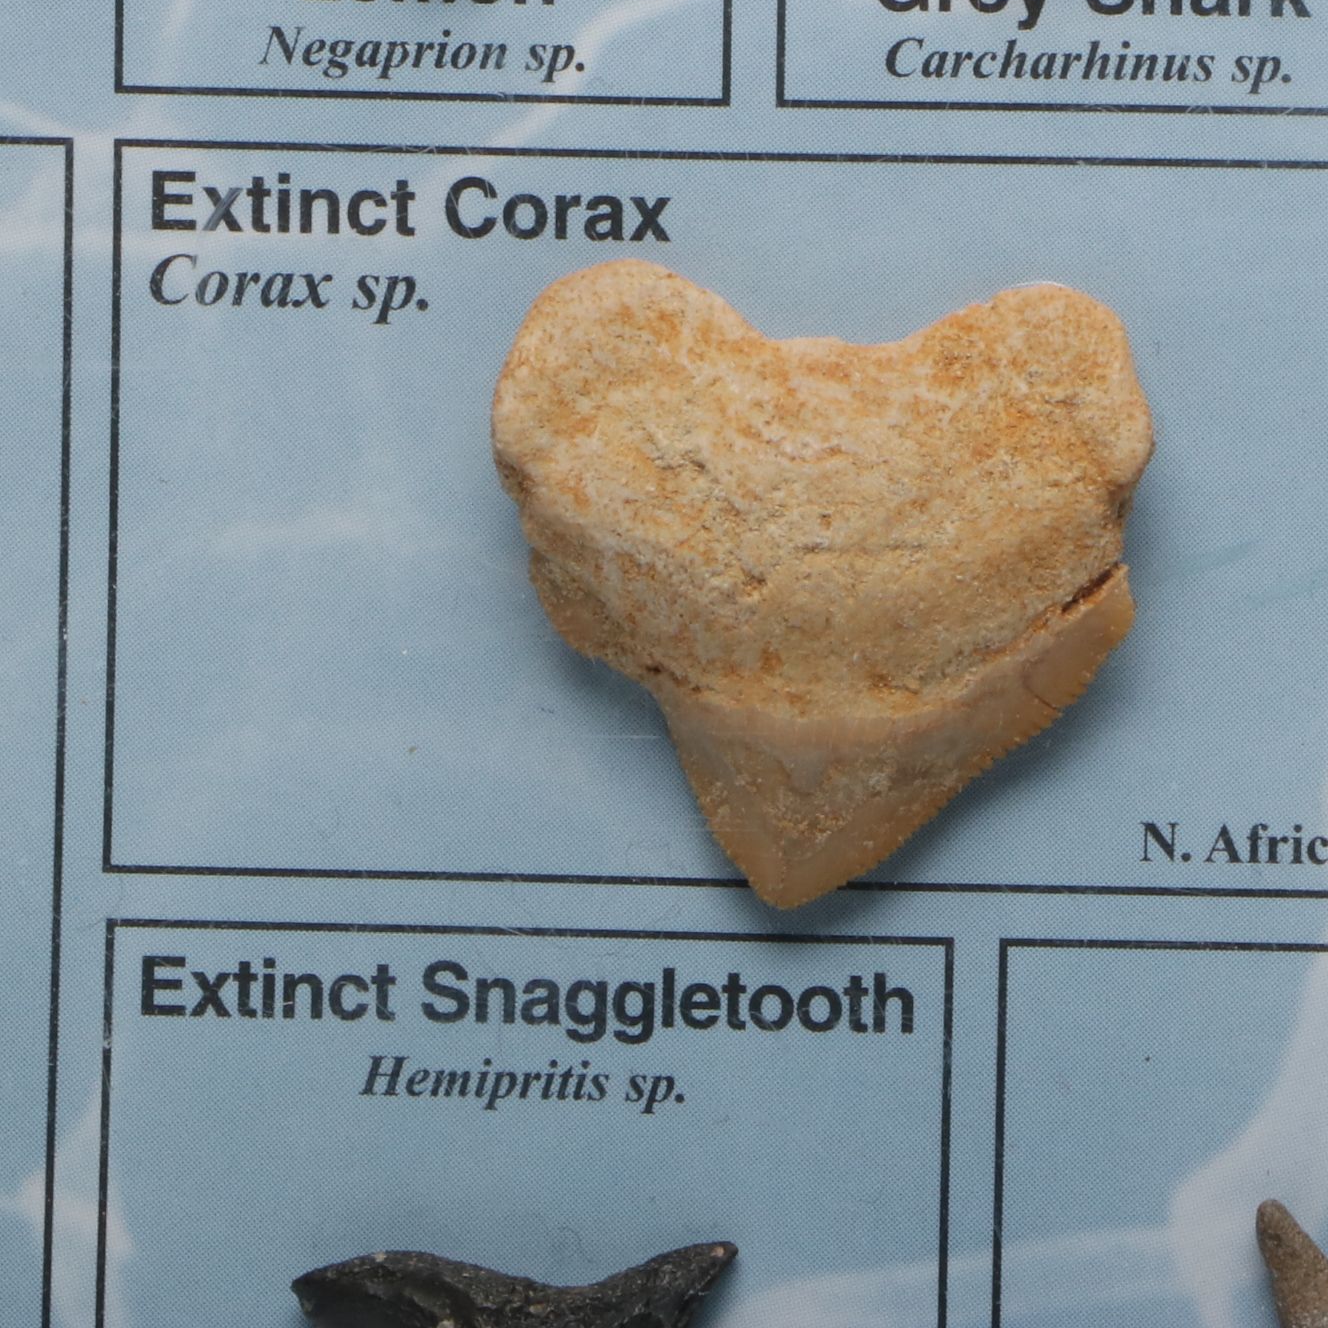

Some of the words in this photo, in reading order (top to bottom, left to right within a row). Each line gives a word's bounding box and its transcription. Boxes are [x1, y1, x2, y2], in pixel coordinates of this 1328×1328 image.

[260, 25, 509, 80] Negaprion
[525, 43, 586, 84] sp.
[884, 38, 1216, 83] Carcharhinus
[1232, 54, 1292, 95] sp.
[151, 170, 416, 237] Extinct
[445, 176, 670, 242] Corax
[149, 256, 333, 309] Corax
[352, 275, 429, 325] sp.
[1140, 821, 1192, 863] N.
[140, 955, 396, 1021] Extinct
[422, 960, 915, 1045] Snaggletooth
[359, 1055, 609, 1111] Hemipritis
[625, 1074, 686, 1115] sp.
